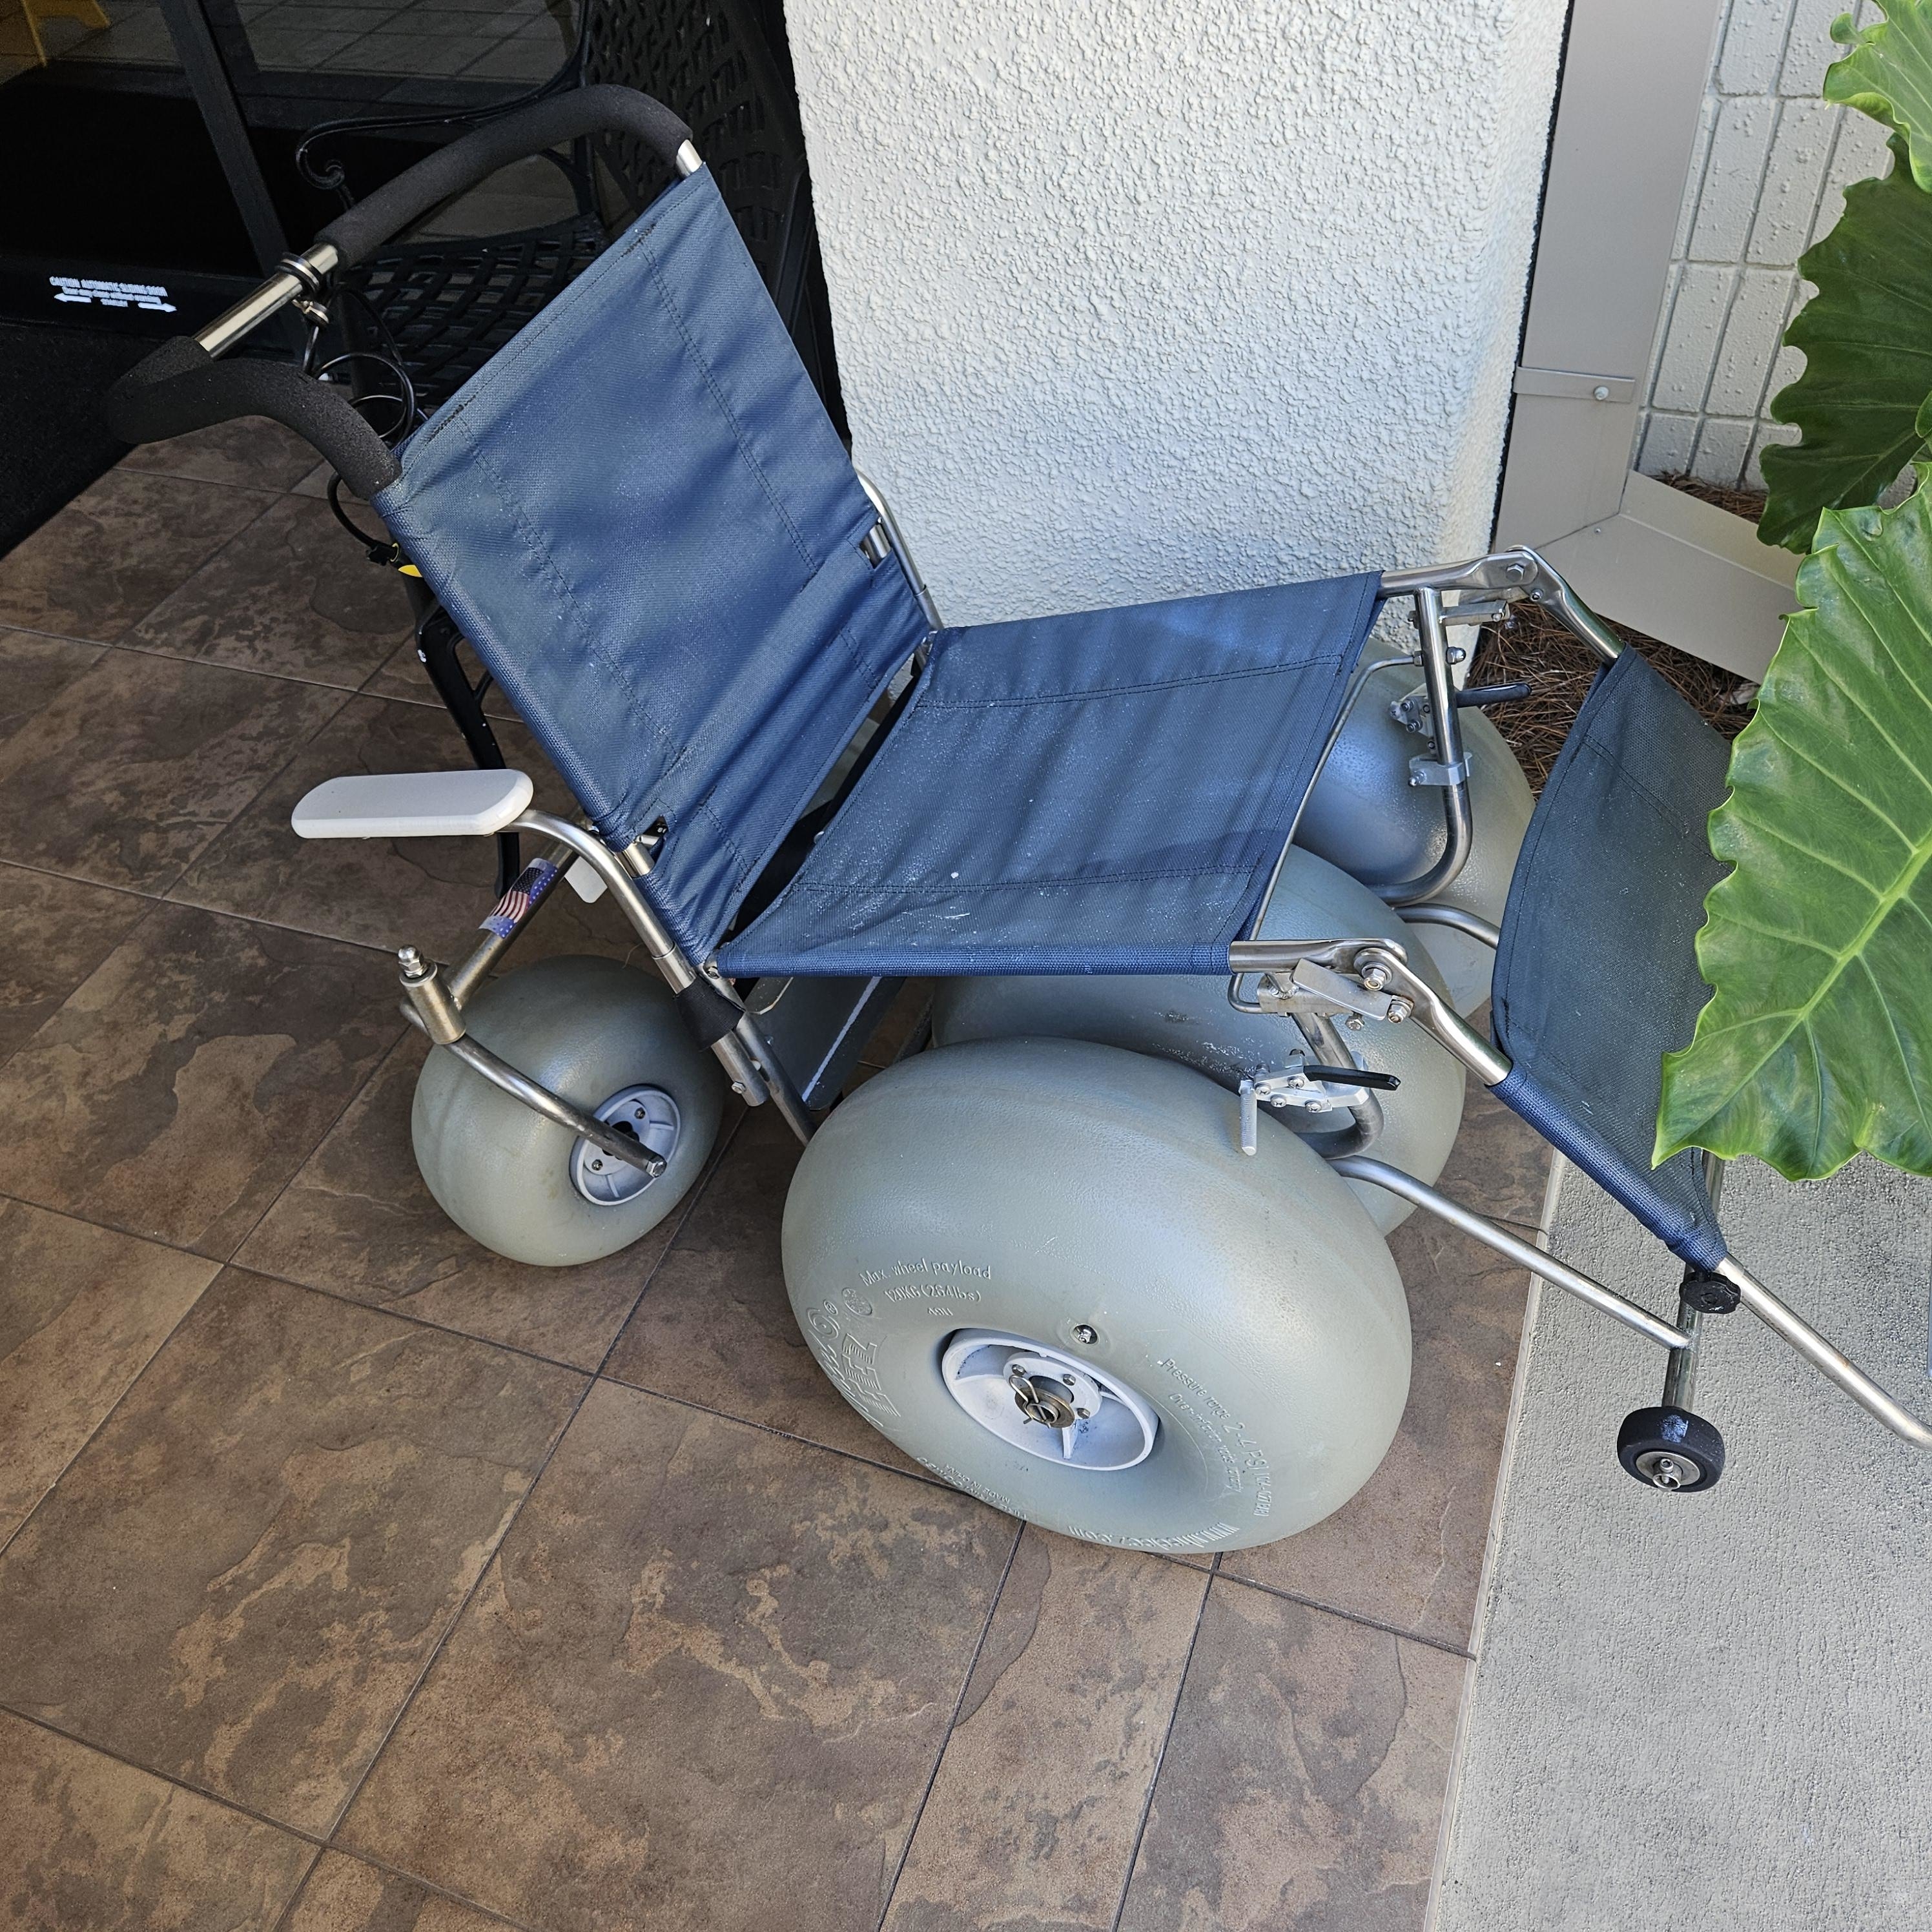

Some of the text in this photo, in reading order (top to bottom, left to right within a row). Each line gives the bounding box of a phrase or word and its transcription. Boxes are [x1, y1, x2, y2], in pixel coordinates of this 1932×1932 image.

[859, 1257, 991, 1286] Max. wheel payload
[1162, 1358, 1208, 1397] Pressure
[1204, 1396, 1231, 1420] range
[945, 1464, 1011, 1505] MADE IN CHINA
